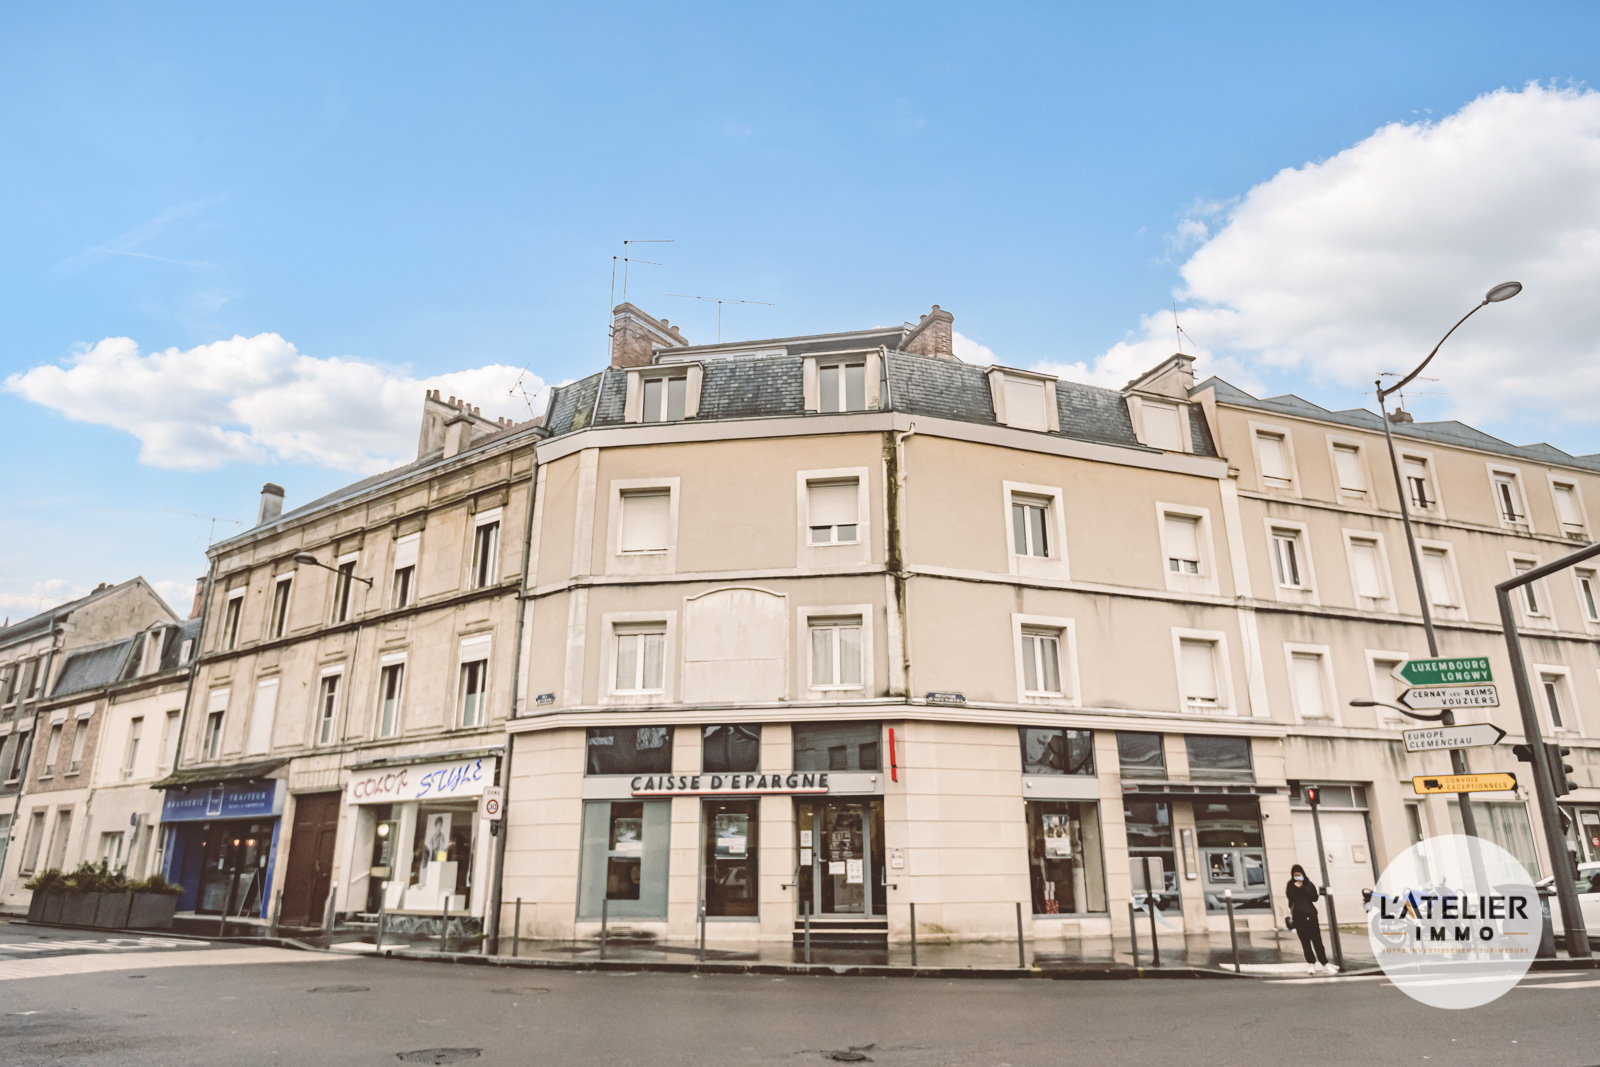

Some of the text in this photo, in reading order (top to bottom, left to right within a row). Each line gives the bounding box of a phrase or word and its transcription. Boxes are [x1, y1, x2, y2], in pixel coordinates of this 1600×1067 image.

[1411, 660, 1487, 672] LUXEMBOURG
[1441, 671, 1488, 681] LONGWY
[1412, 690, 1446, 698] CERNAY
[1464, 688, 1494, 696] REIMS
[1441, 697, 1495, 705] VOUZIERS
[1408, 731, 1444, 740] EUROPE
[1410, 737, 1472, 748] CLEMENCEAU
[353, 759, 482, 798] COLOR STYLE
[631, 774, 829, 791] CAISSE D'EPARGNE
[1444, 776, 1478, 784] CONVOIS
[1446, 782, 1508, 790] EXCEPTIONNELS
